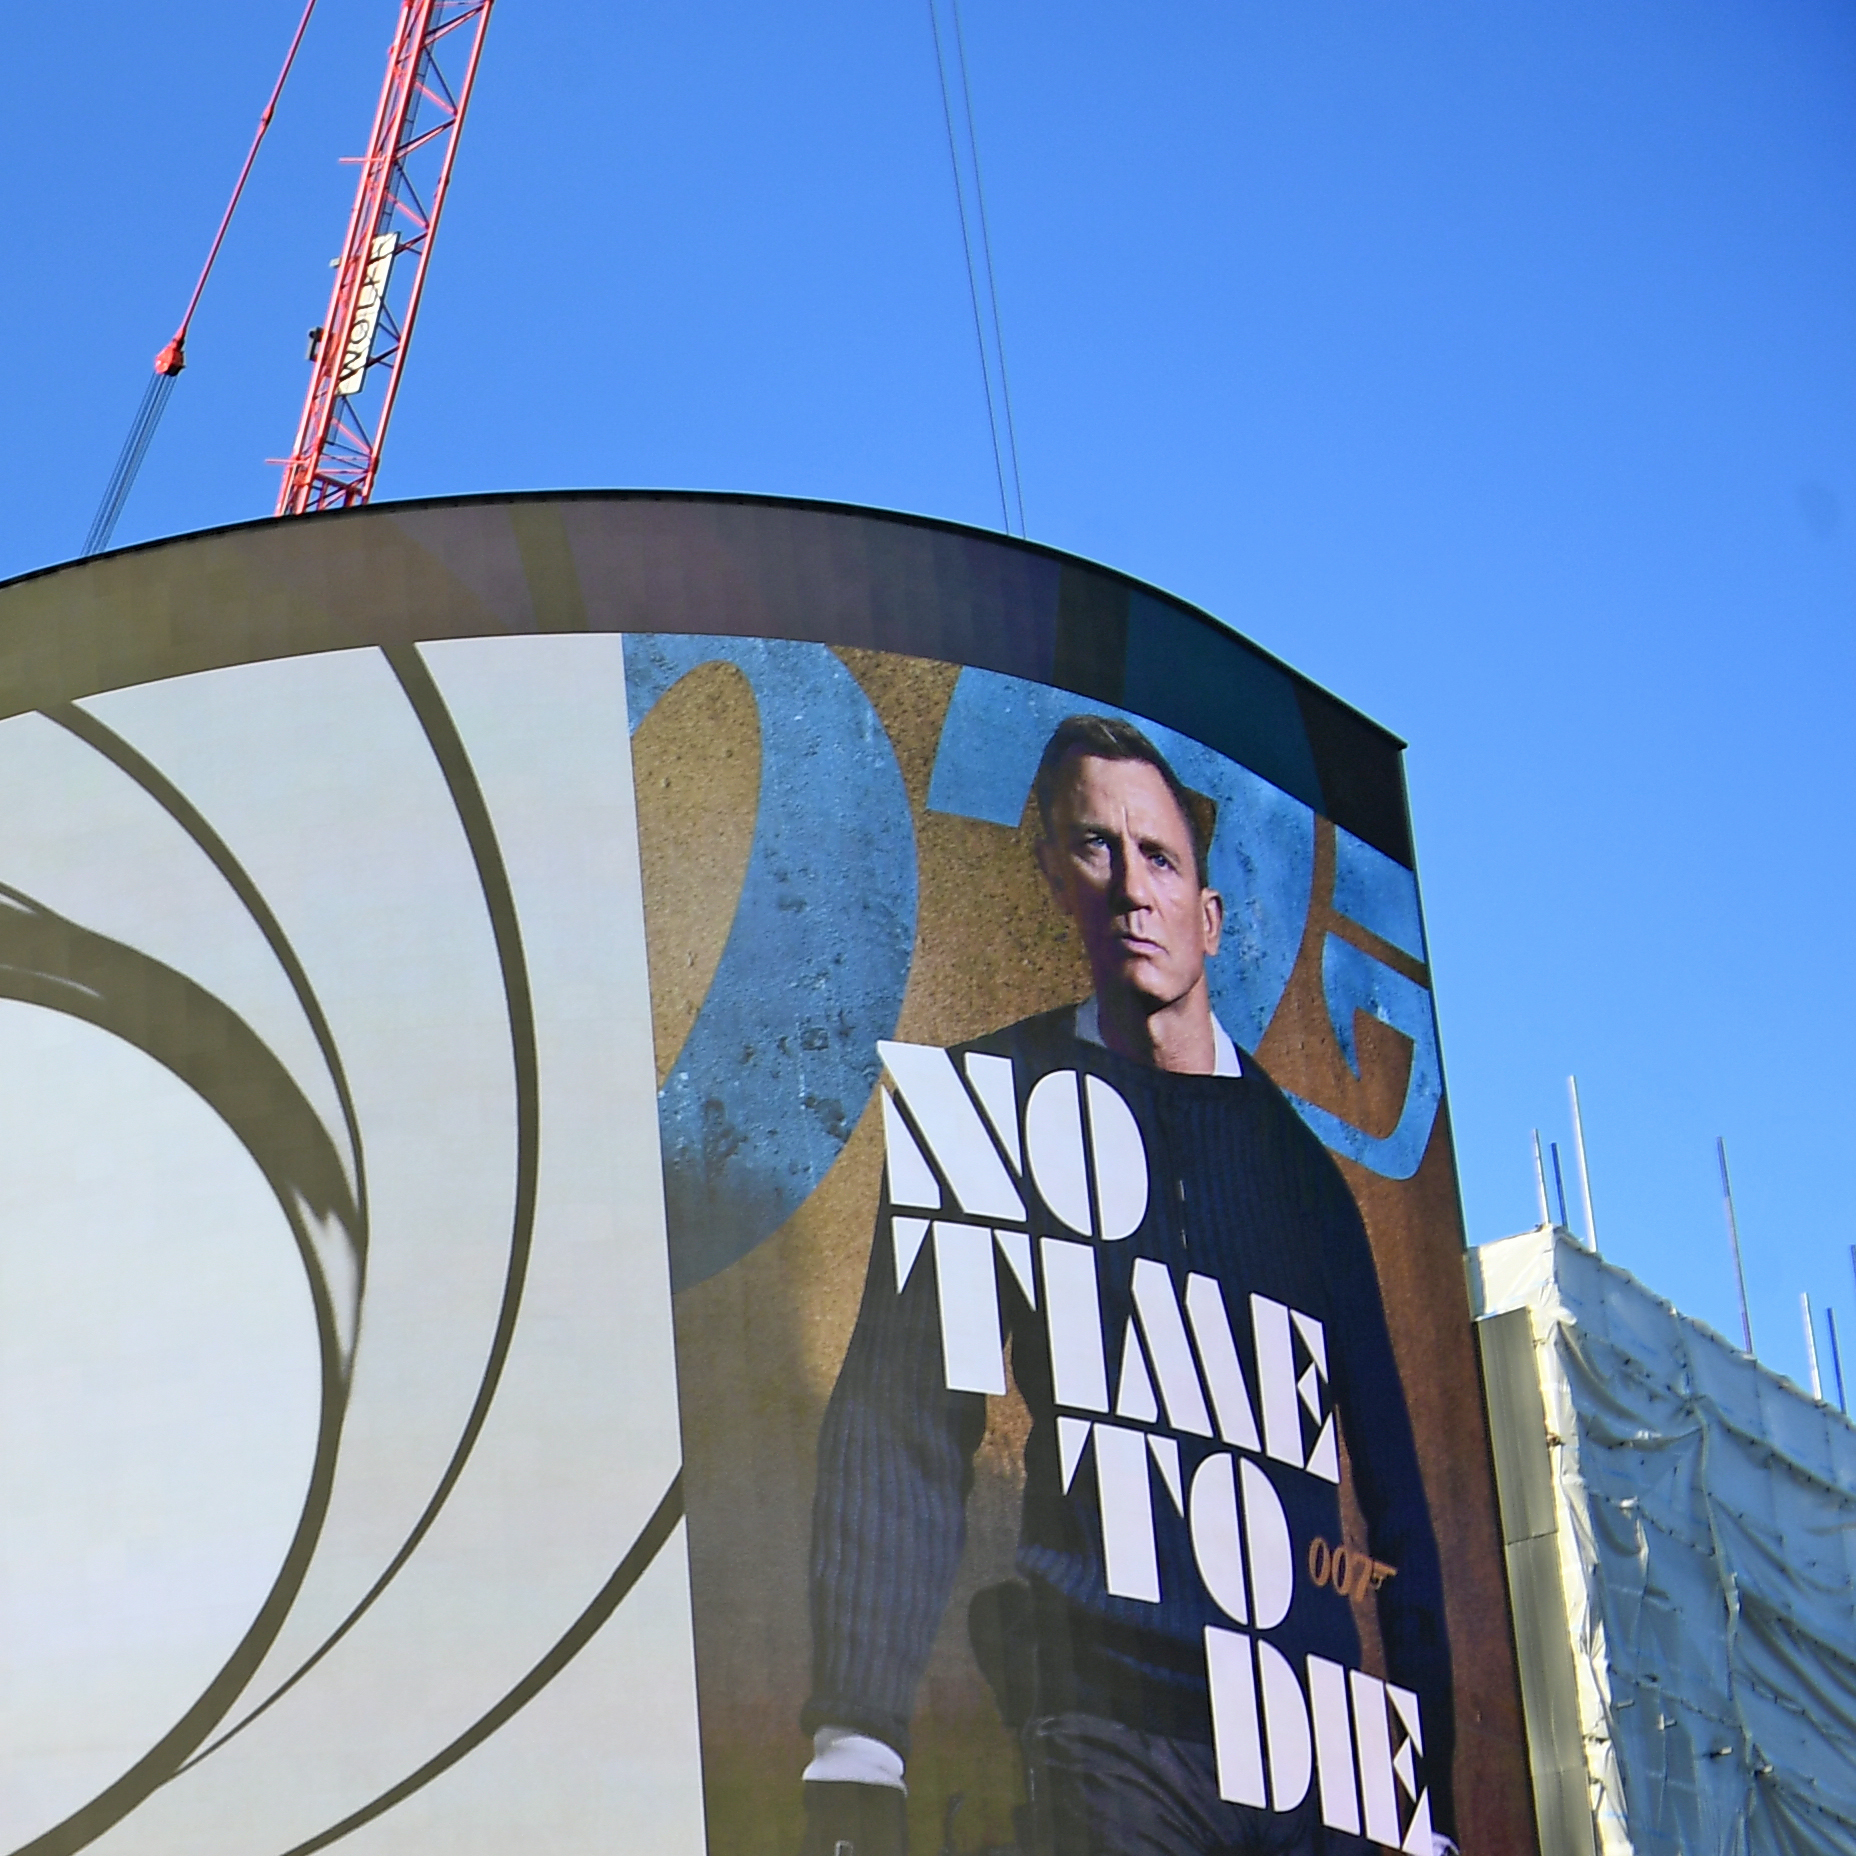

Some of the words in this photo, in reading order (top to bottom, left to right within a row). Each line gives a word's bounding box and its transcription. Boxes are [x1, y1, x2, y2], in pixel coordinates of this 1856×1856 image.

[877, 1040, 1149, 1241] NO
[892, 1216, 1340, 1484] TIME
[1056, 1416, 1295, 1630] TO
